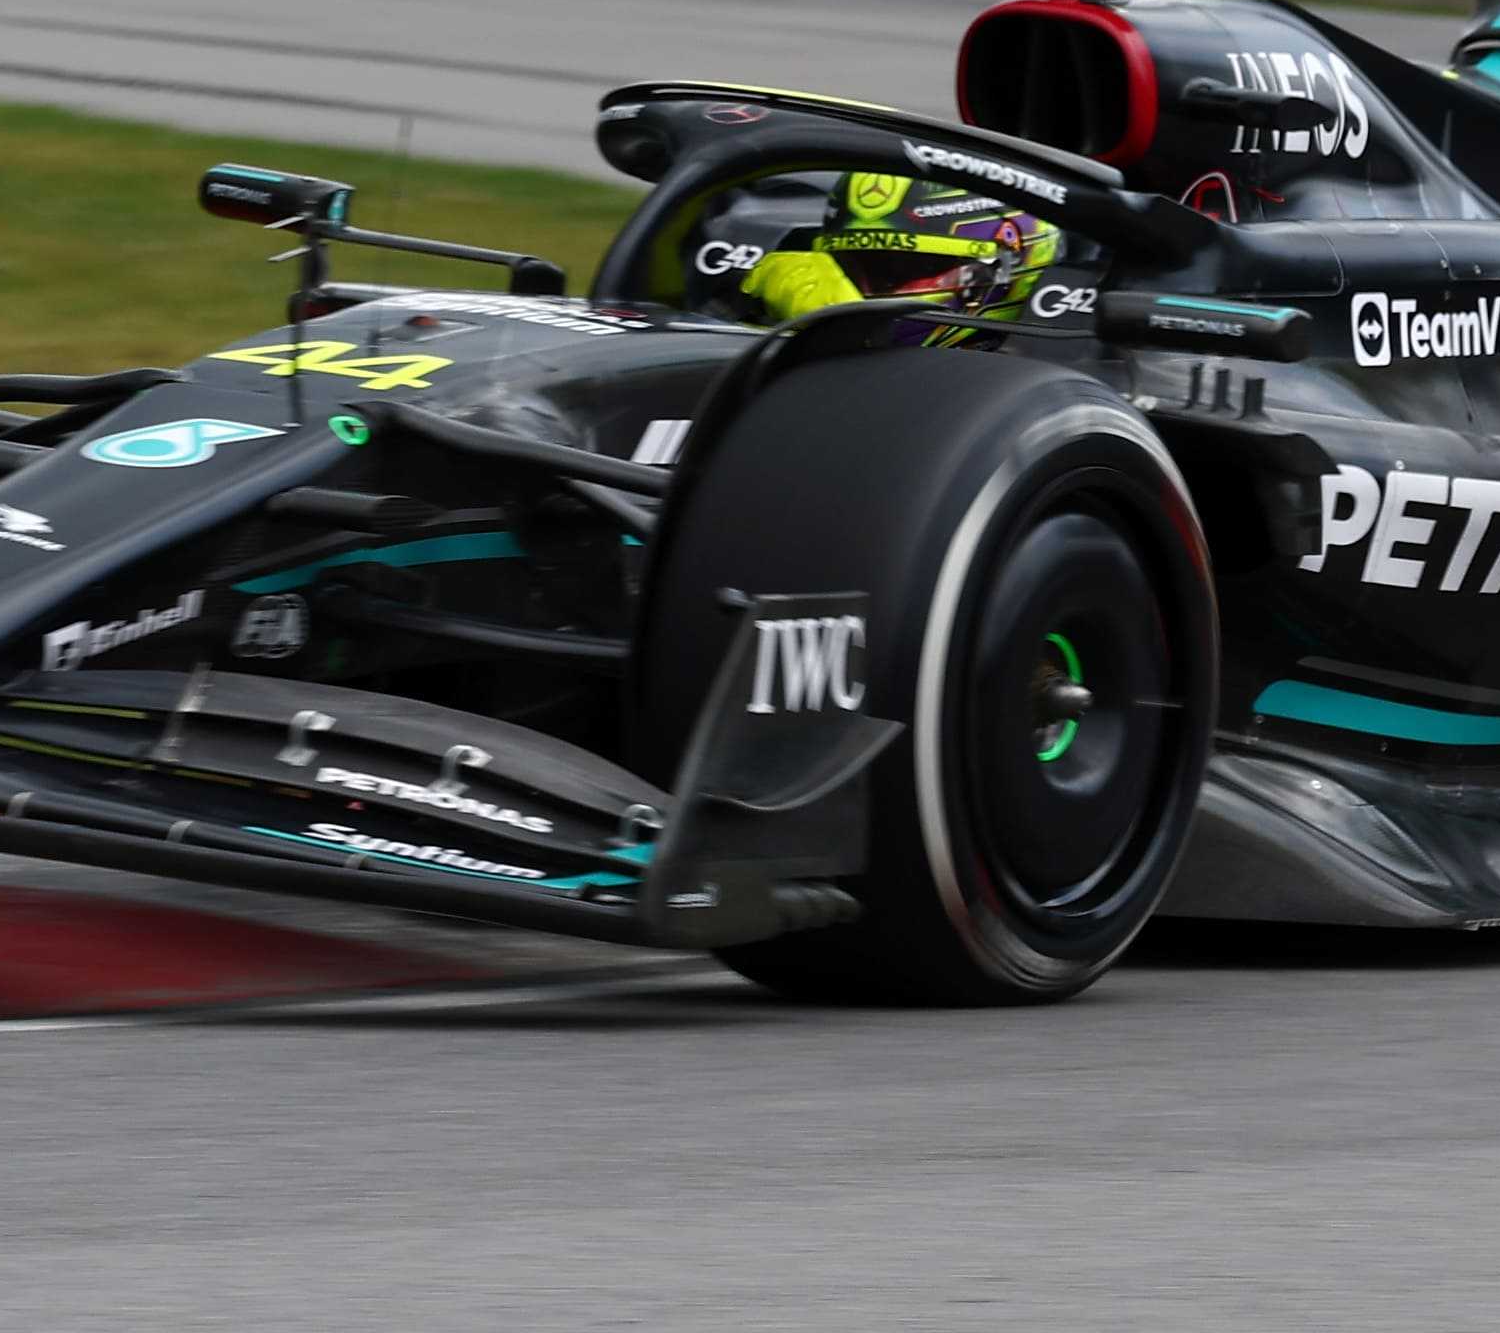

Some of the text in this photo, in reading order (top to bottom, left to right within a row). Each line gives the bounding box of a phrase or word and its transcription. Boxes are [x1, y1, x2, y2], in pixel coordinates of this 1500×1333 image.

[914, 144, 1069, 206] CROWDSTRIKE
[913, 197, 1005, 218] CROWDSTRI
[695, 239, 764, 276] G42
[1030, 284, 1098, 319] G42
[1148, 314, 1246, 337] PETRONAS
[207, 340, 455, 390] 44
[746, 614, 866, 714] IWC
[314, 766, 554, 834] PETRONAS
[308, 822, 548, 880] Syntium
